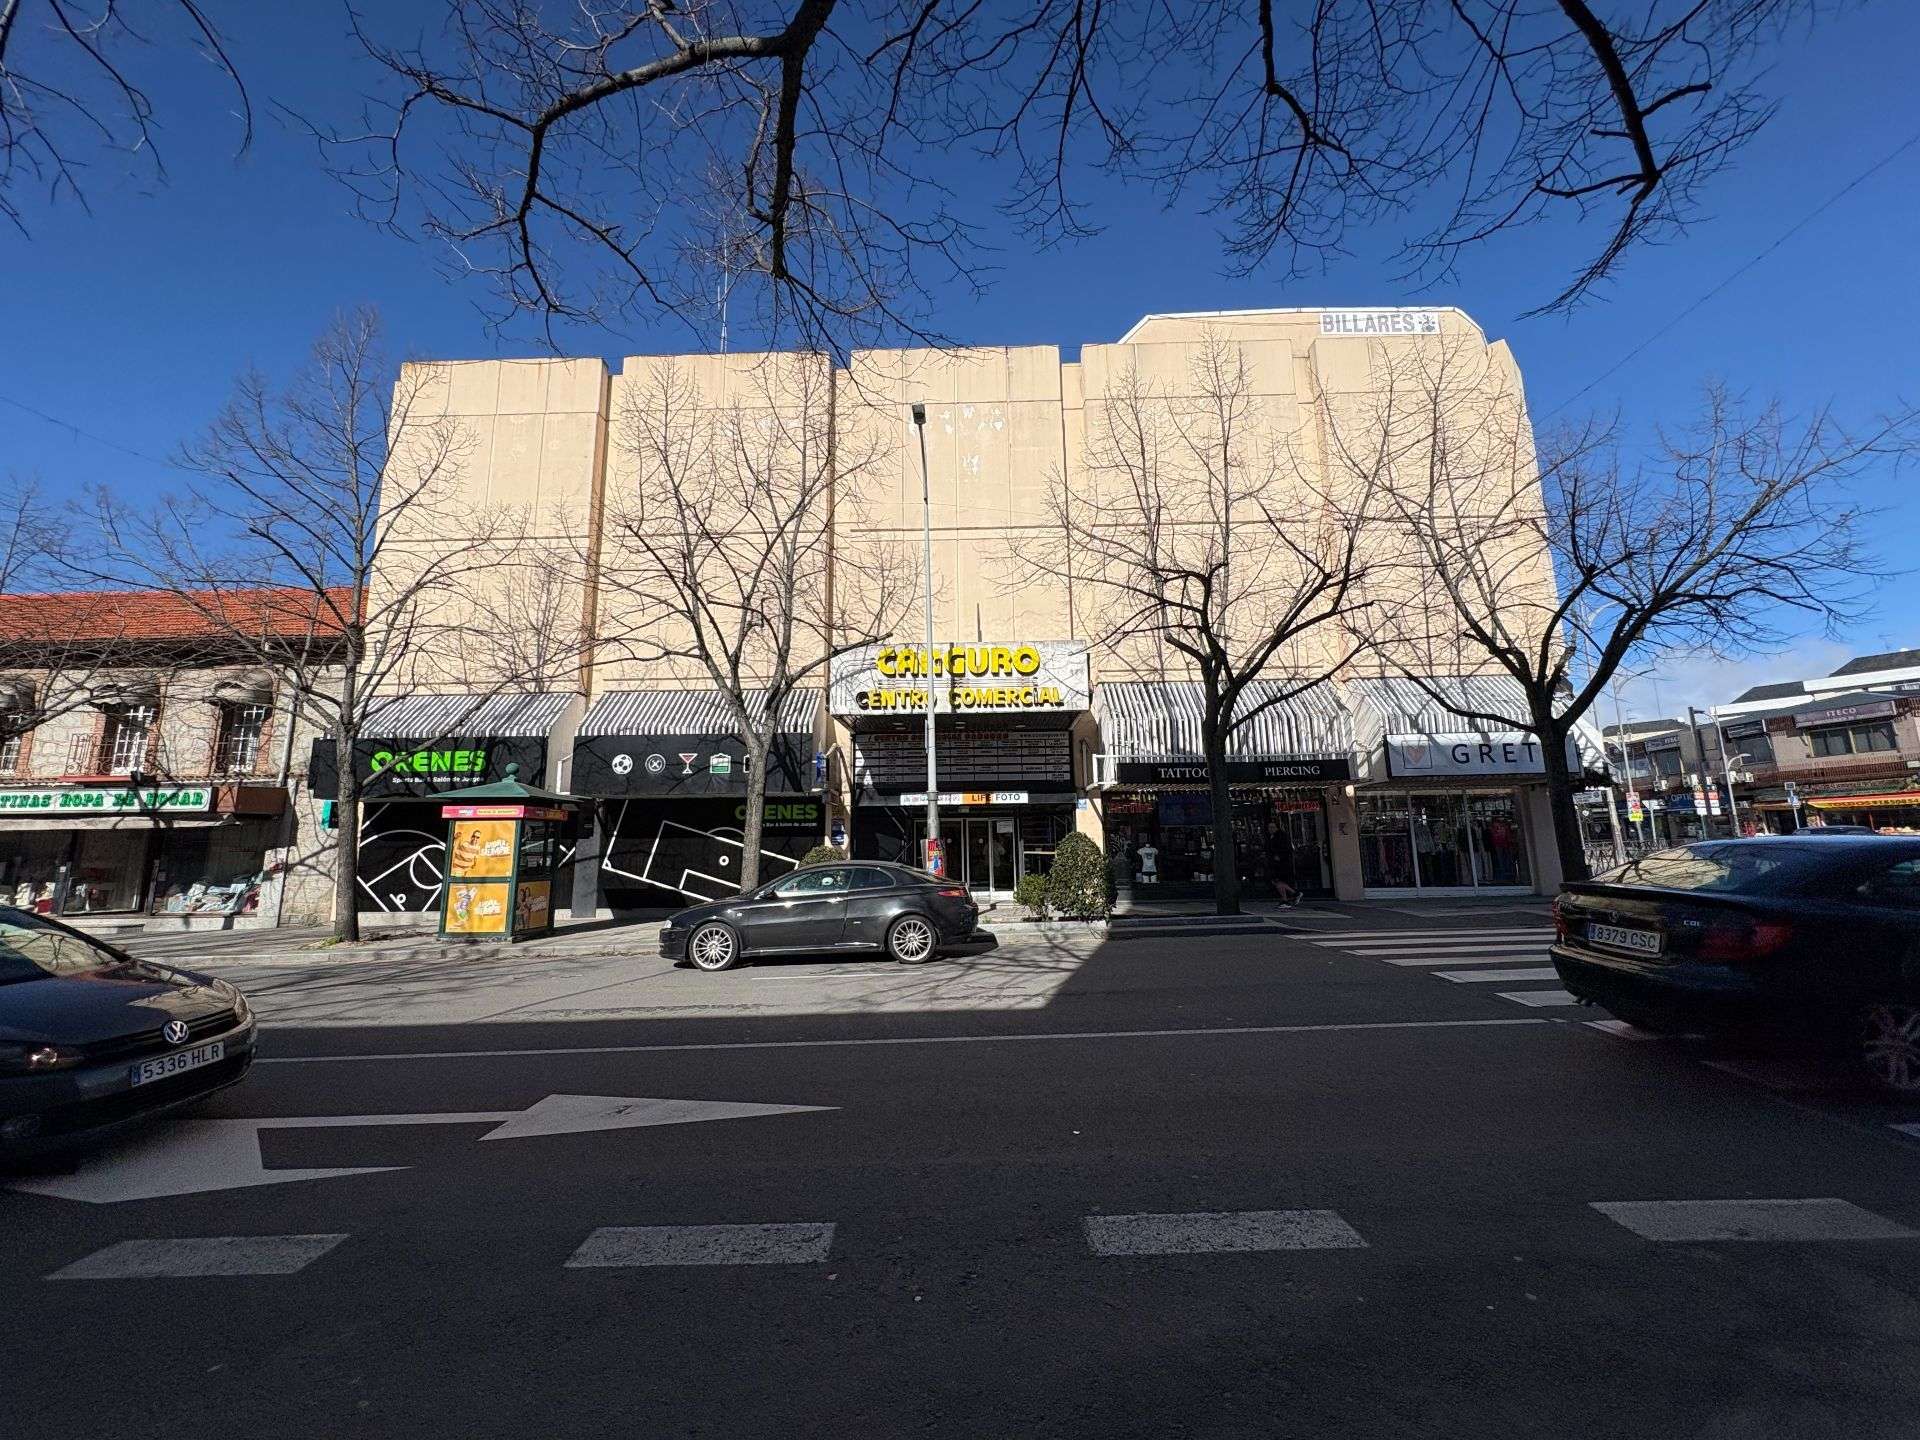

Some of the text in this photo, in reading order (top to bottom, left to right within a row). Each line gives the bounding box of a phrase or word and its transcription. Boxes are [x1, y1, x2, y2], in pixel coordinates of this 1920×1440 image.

[1322, 314, 1415, 332] BILLARES
[875, 646, 1040, 677] CANGURO
[948, 687, 1064, 708] COMERCIAL
[1826, 707, 1857, 717] ITECO
[371, 750, 486, 772] ORENES
[1264, 765, 1321, 776] PIERCING
[59, 793, 104, 808] ROPA
[972, 794, 991, 802] LIFE
[735, 804, 818, 820] OENES
[1597, 927, 1656, 948] 8379 CSC
[144, 1045, 219, 1079] 5336 HLR
